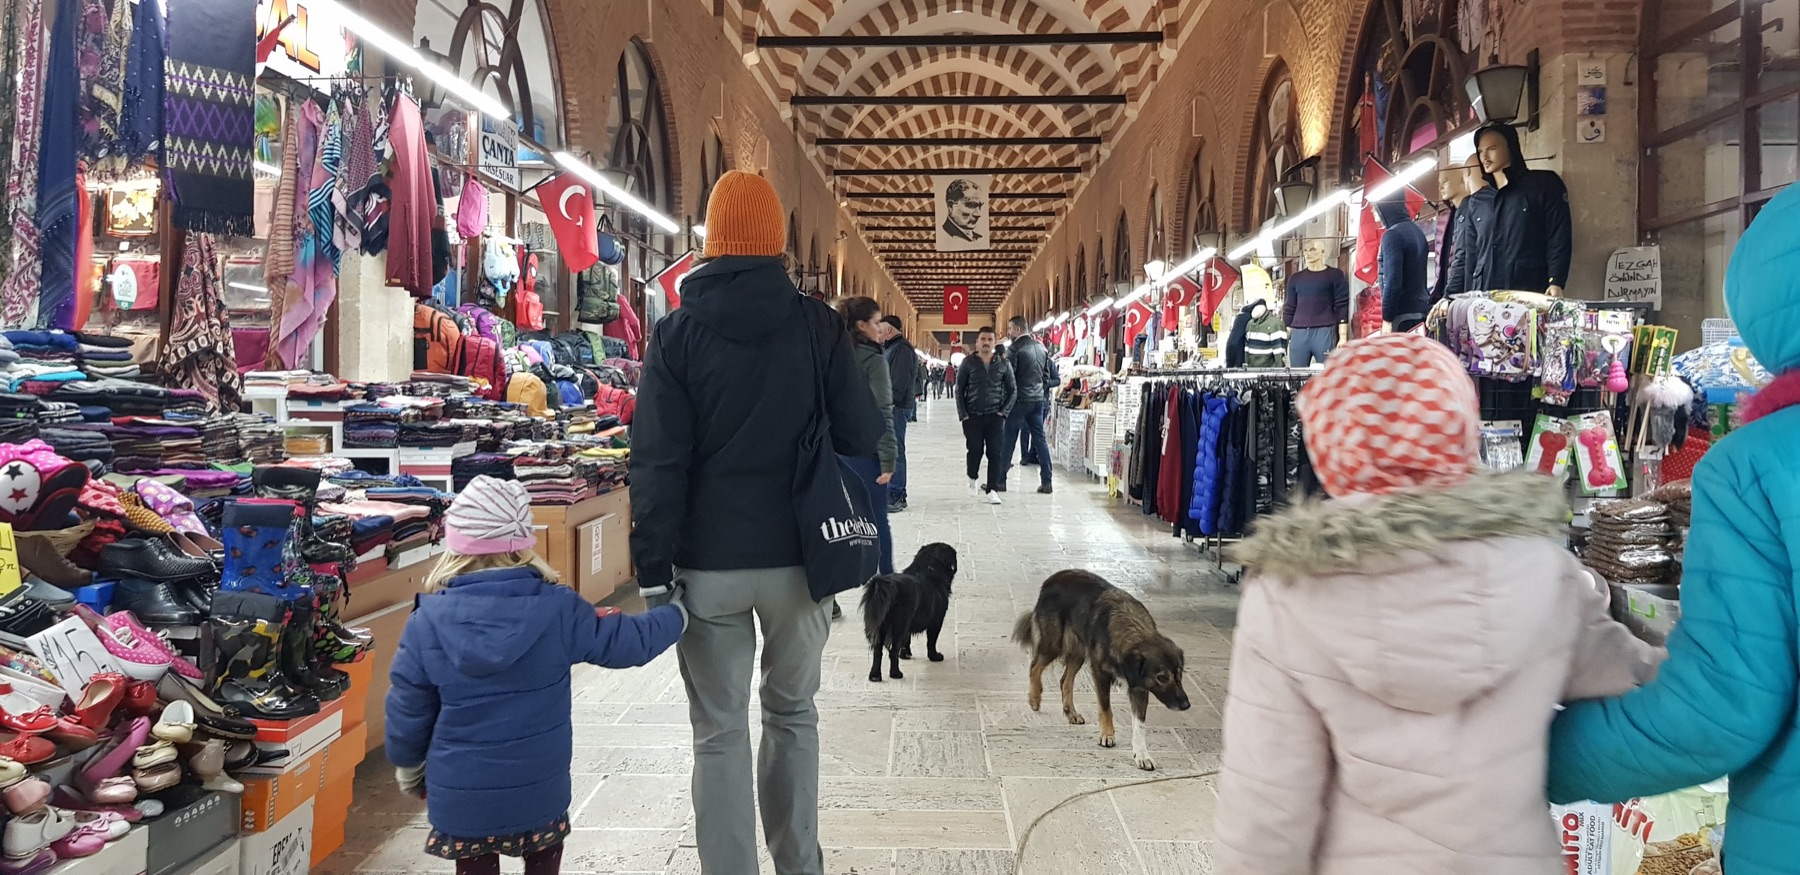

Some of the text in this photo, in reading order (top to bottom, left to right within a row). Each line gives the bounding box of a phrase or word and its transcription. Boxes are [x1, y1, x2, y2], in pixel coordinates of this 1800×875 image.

[256, 0, 321, 75] AL
[482, 135, 515, 168] ÇANTA
[484, 161, 514, 185] AKSESUAR
[1608, 271, 1658, 283] ÖNÜNDE
[1607, 281, 1658, 301] DURMAYIN
